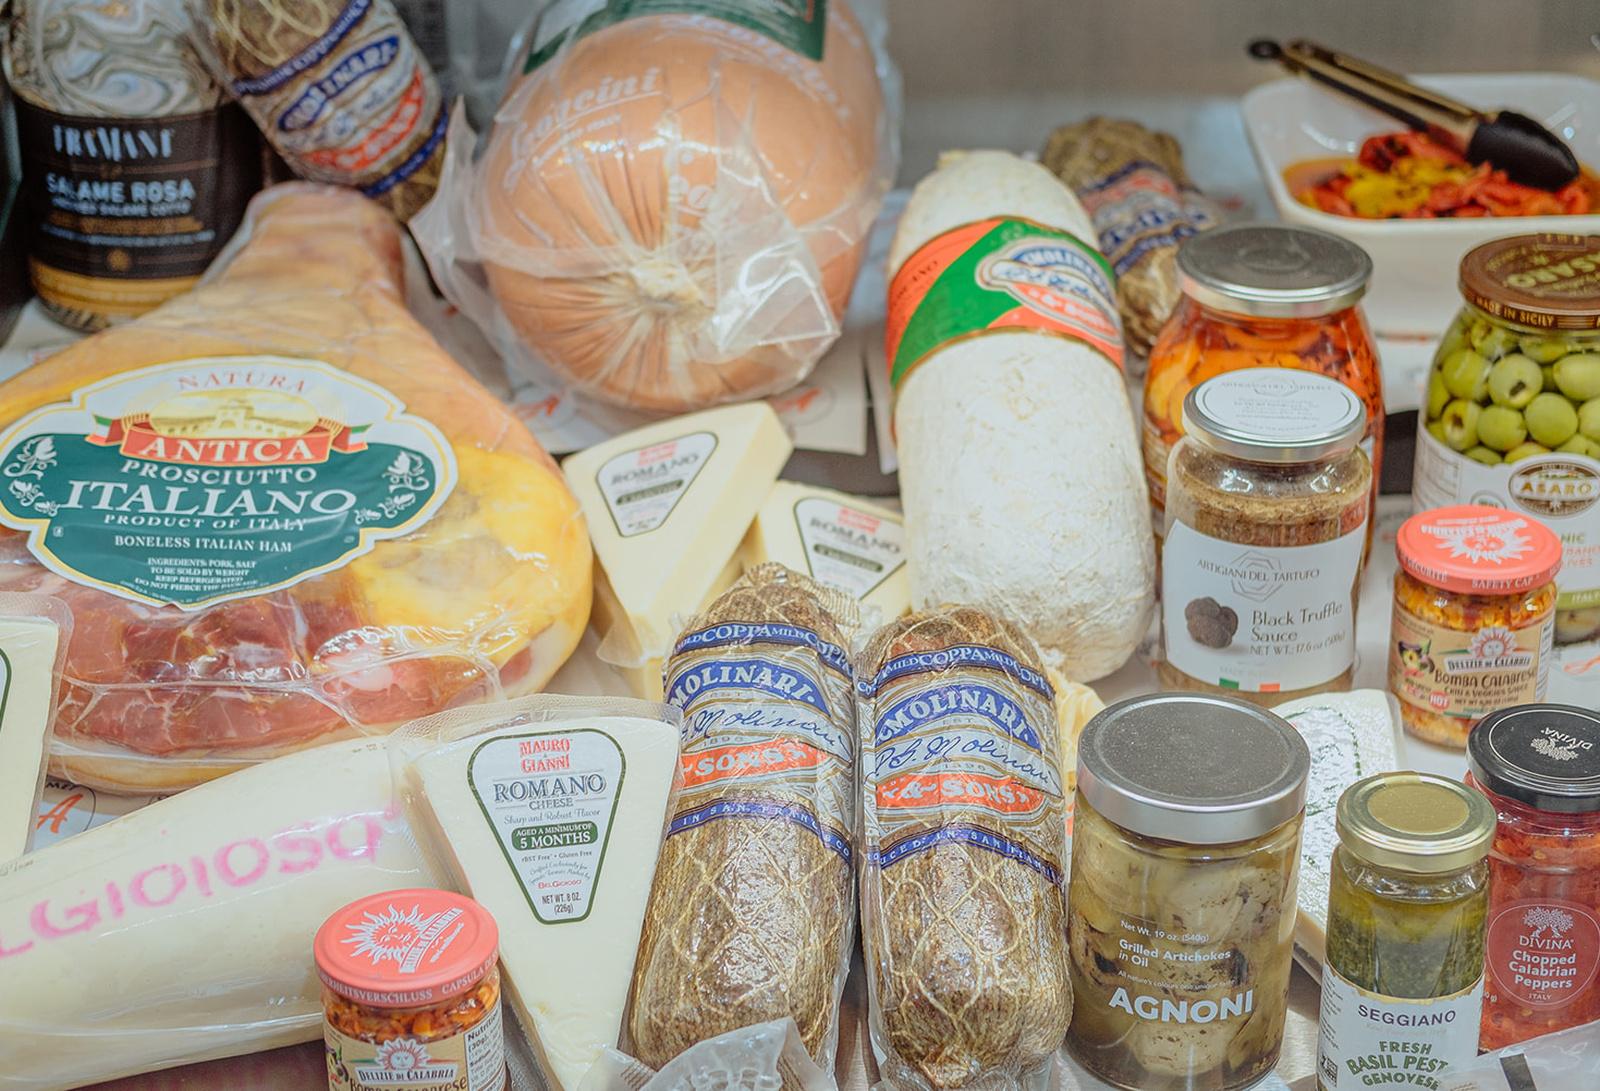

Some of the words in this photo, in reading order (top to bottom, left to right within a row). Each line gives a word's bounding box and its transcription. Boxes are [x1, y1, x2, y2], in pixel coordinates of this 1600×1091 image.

[131, 179, 196, 203] ROSA
[1475, 297, 1501, 315] MADE
[1503, 304, 1516, 317] IN
[1519, 311, 1554, 326] SICILY
[178, 372, 306, 392] NATURA
[141, 438, 315, 464] ANTICA
[121, 460, 318, 487] PROSCIUTTO
[610, 454, 699, 485] ROMANO
[61, 480, 358, 519] ITALIANO
[105, 514, 206, 529] PRODUCT
[212, 517, 241, 530] OF
[248, 518, 306, 532] ITALY
[115, 534, 191, 550] BONELESS
[195, 537, 256, 552] ITALIAN
[260, 538, 293, 553] HAM
[151, 567, 162, 576] TO
[165, 567, 178, 576] BE
[181, 567, 202, 577] SOLD
[204, 567, 217, 577] BY
[219, 567, 250, 577] WEIGHT
[236, 560, 258, 569] SALT
[1249, 570, 1268, 581] DEL
[1273, 569, 1321, 582] TARTUFO
[1472, 579, 1511, 589] SAFETY
[1252, 609, 1294, 626] Black
[1301, 601, 1344, 624] Truffle
[702, 625, 771, 643] COPPA
[772, 629, 806, 642] MILD
[1252, 627, 1298, 643] Sauce
[919, 648, 986, 667] COPPA
[1250, 645, 1272, 656] NET
[1430, 696, 1448, 707] HOT
[887, 691, 1027, 737] MOLINARI
[519, 739, 570, 757] MAURO
[1544, 728, 1593, 750] DIVINA
[521, 754, 570, 774] GIANNI
[696, 748, 784, 776] SONS
[493, 774, 606, 803] ROMANO
[941, 780, 1017, 804] SONS
[529, 798, 573, 811] CHEESE
[504, 813, 527, 826] Sharp
[528, 811, 543, 823] and
[544, 809, 572, 821] Robust
[515, 827, 536, 838] AGED
[546, 823, 579, 836] MINIMUM
[684, 813, 701, 827] IN
[710, 803, 751, 815] SAN
[762, 807, 852, 857] FRANCSCO
[519, 837, 528, 850] 5
[531, 830, 591, 848] MONTHS
[936, 831, 957, 844] IN
[970, 831, 1001, 848] SAN
[542, 895, 554, 905] NET
[555, 903, 574, 915] (226g)
[1121, 920, 1135, 932] Net
[1137, 926, 1152, 937] Wt.
[1155, 930, 1165, 939] 19
[1167, 933, 1180, 941] oz.
[1182, 933, 1210, 943] (540g)
[1119, 939, 1159, 958] Grilled
[1162, 949, 1231, 962] Artichokes
[1519, 935, 1572, 950] DIVINA
[1119, 951, 1129, 961] in
[1131, 954, 1149, 967] Oil
[1513, 950, 1576, 968] Chopped
[1509, 961, 1577, 977] Calabrian
[442, 967, 484, 995] CAPSULA
[1515, 974, 1573, 991] Peppers
[1109, 987, 1254, 1024] AGNONI
[1529, 993, 1551, 1001] ITALY
[1358, 1004, 1456, 1027] SEGGIANO
[1379, 1041, 1432, 1055] FRESH
[1346, 1055, 1398, 1075] BASIL
[1403, 1055, 1449, 1073] PEST
[358, 1070, 393, 1081] DELIZIE
[406, 1069, 454, 1081] CALABRIA
[1361, 1072, 1440, 1090] GENOVESE
